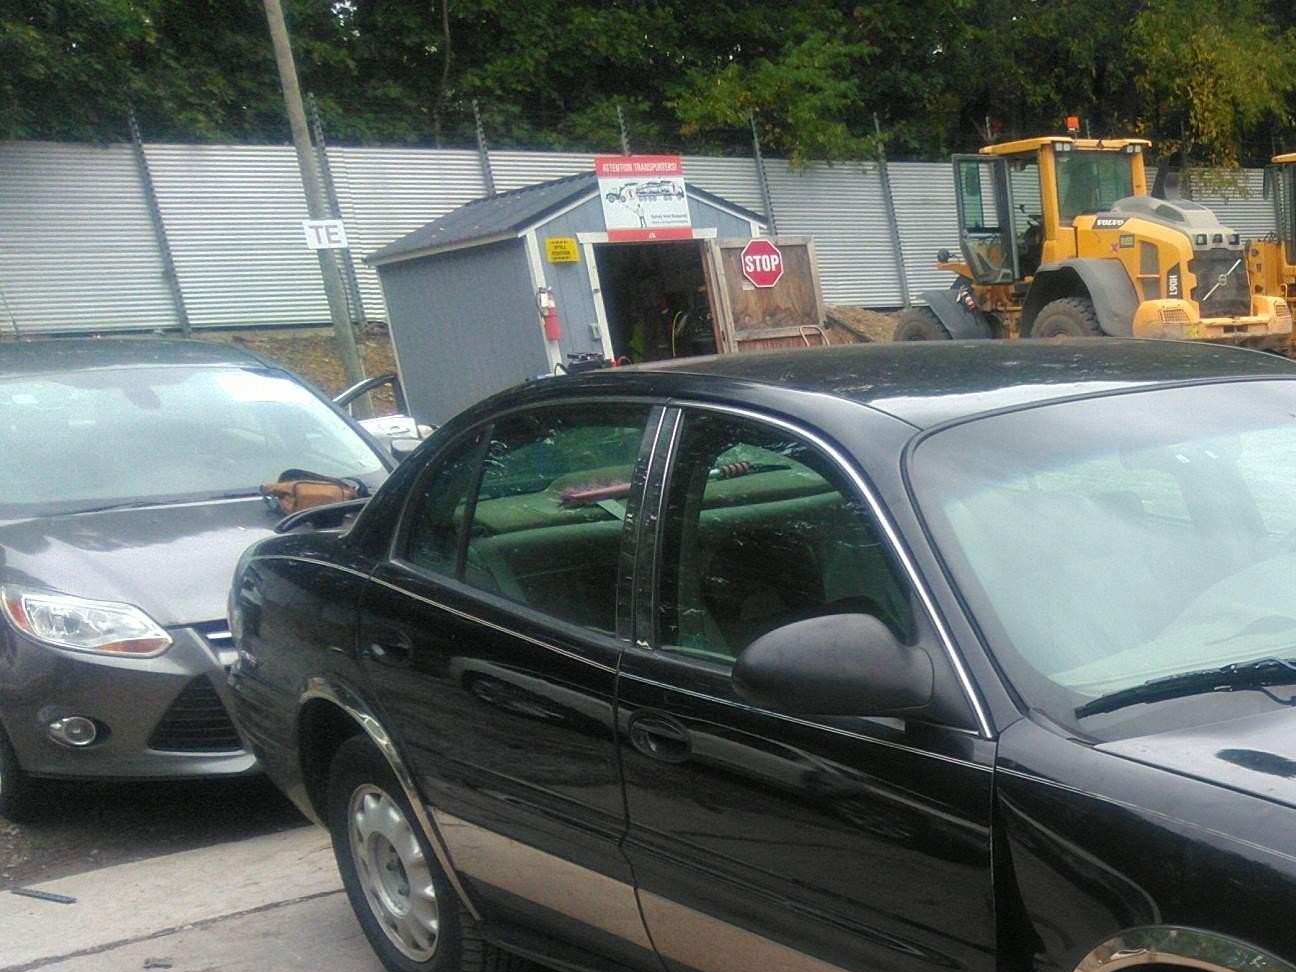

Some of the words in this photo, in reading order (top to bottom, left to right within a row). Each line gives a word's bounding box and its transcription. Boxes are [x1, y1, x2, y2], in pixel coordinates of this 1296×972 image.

[602, 163, 633, 172] ATTENTION
[308, 224, 342, 245] TE
[744, 254, 780, 272] STOP
